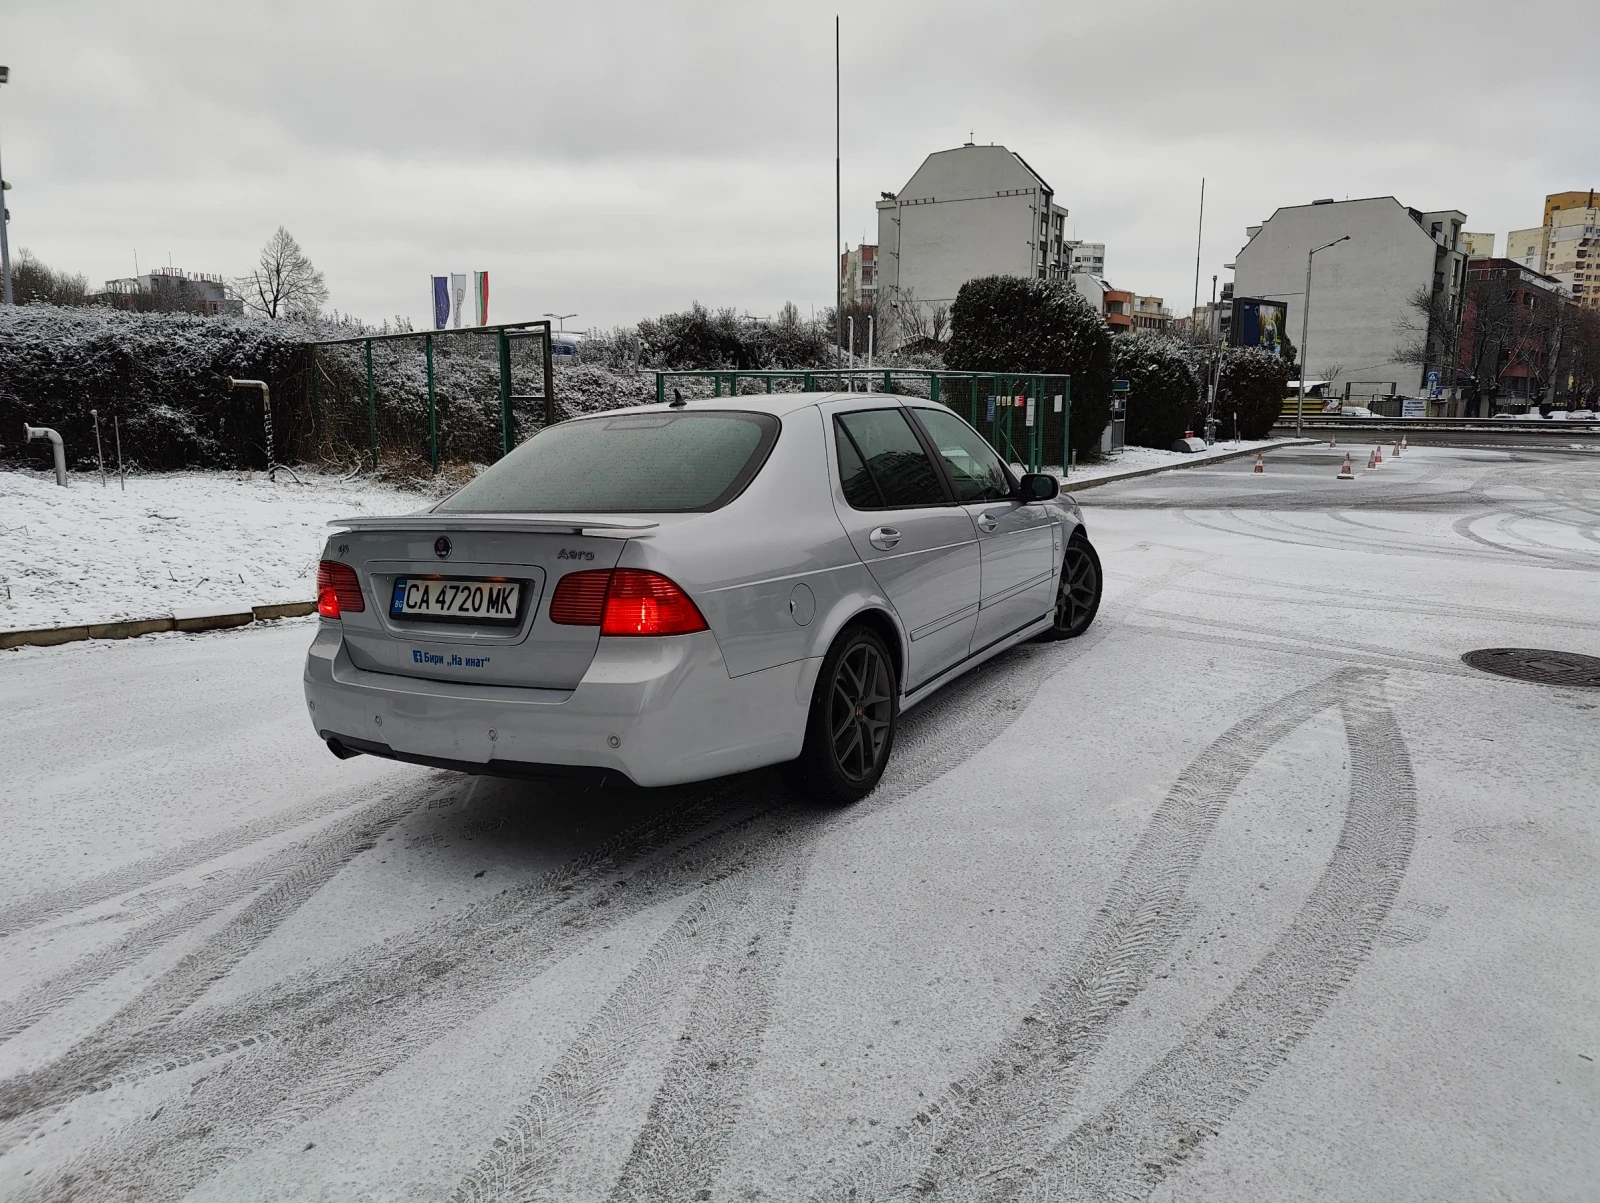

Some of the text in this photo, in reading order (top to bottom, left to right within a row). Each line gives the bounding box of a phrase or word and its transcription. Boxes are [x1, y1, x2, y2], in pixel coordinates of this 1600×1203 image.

[161, 266, 184, 278] ХОТЕЛ
[187, 271, 223, 284] СИМОНА
[556, 548, 595, 561] Aero
[394, 600, 404, 608] BG
[406, 584, 515, 615] CA 4720 MK
[424, 652, 444, 665] Бири
